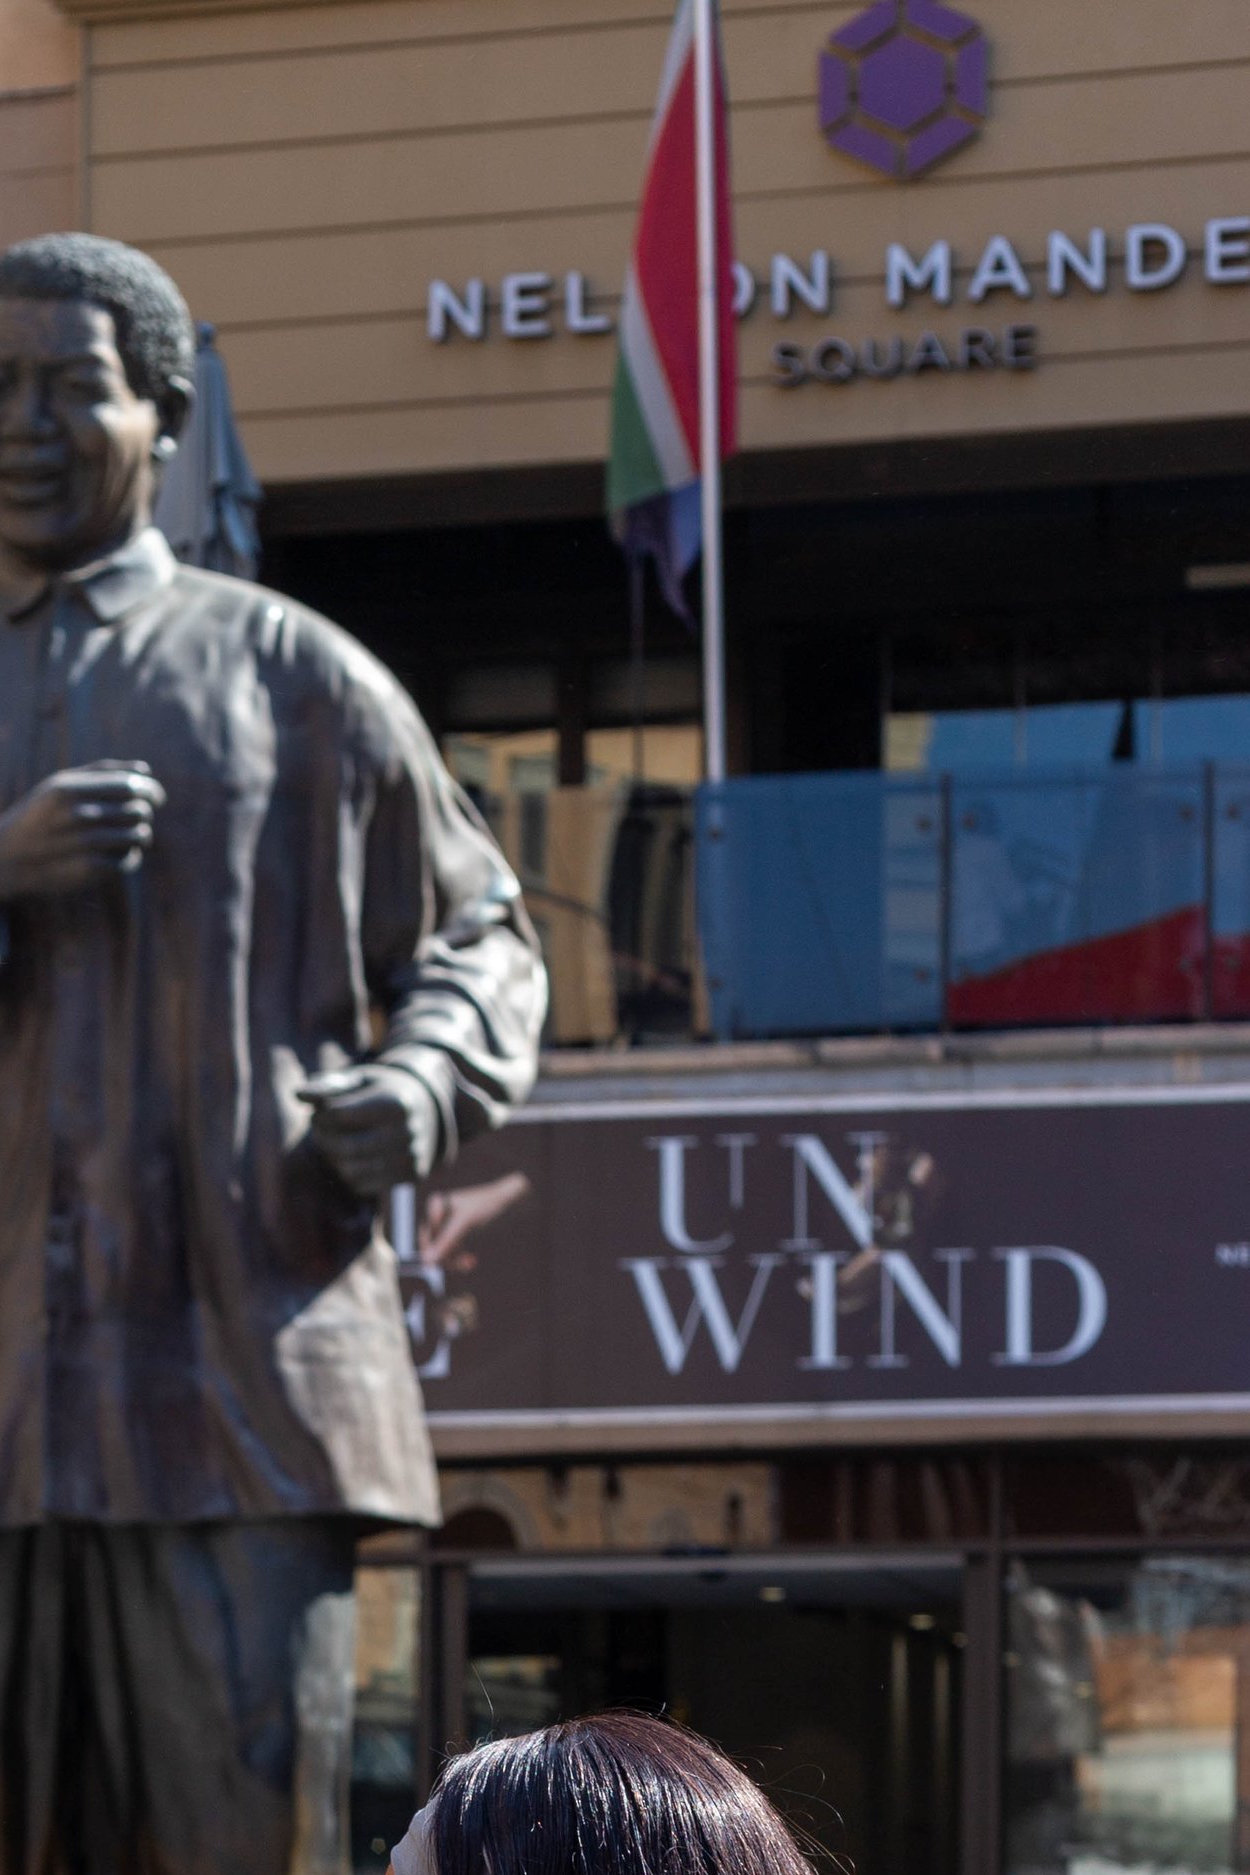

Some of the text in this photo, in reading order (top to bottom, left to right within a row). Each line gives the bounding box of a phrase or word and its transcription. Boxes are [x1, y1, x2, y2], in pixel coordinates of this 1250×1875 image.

[427, 216, 1250, 341] NELN MANDE
[771, 325, 1037, 385] SQUARE
[644, 1130, 888, 1253] UN
[618, 1245, 1108, 1374] WIND
